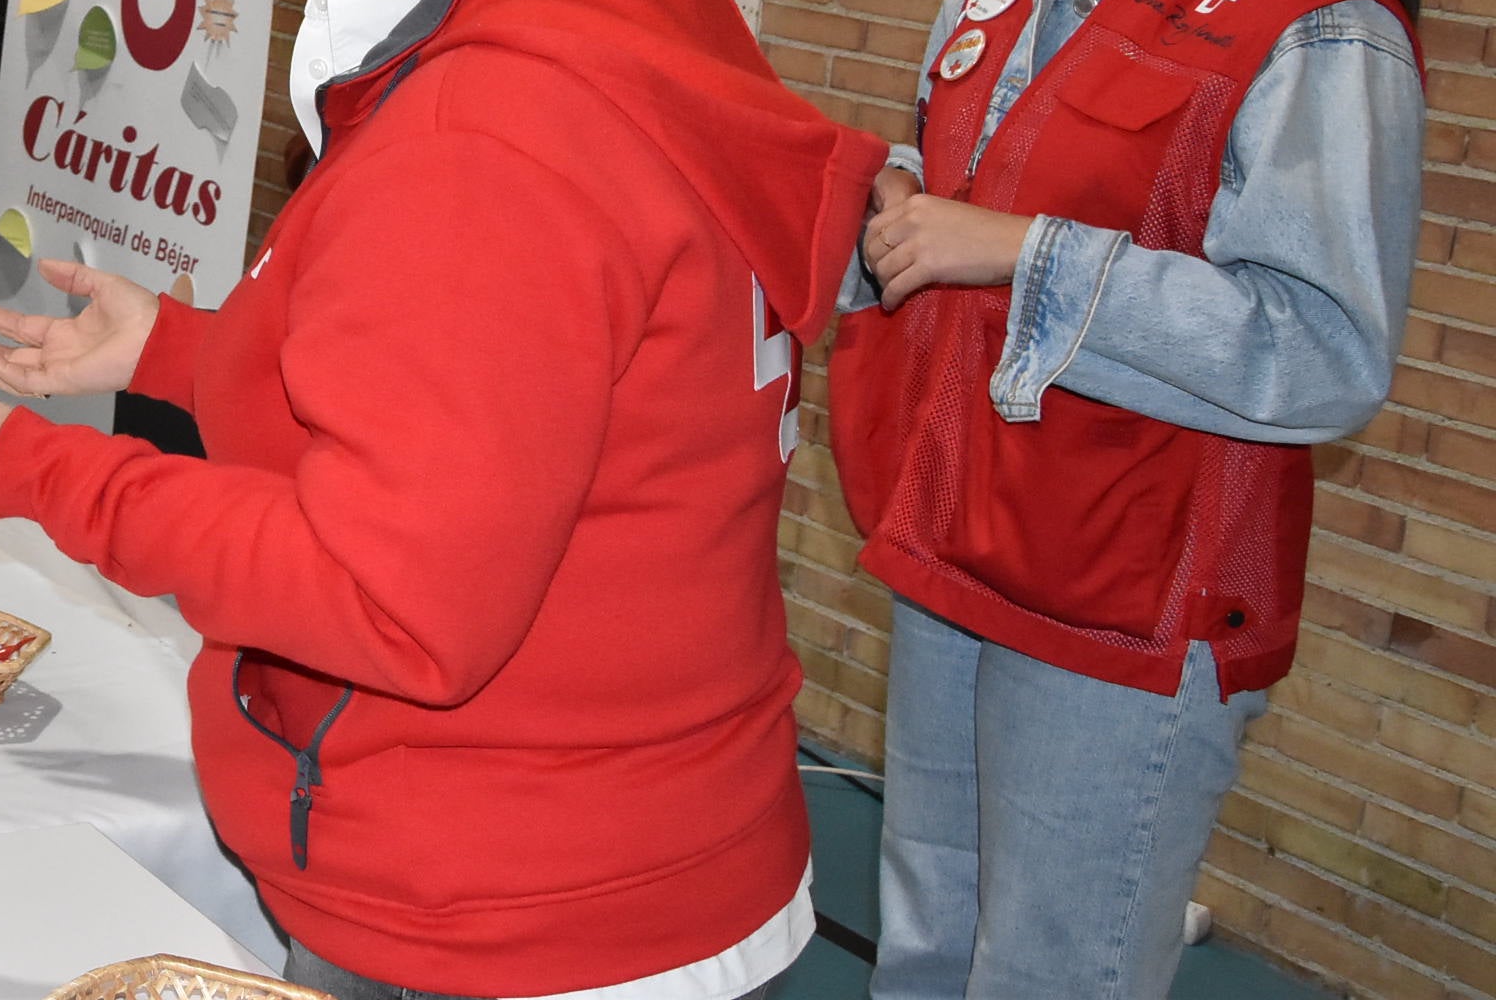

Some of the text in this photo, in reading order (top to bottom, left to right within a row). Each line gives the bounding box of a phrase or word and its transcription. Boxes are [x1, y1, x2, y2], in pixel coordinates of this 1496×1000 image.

[23, 95, 222, 226] Cáritas
[26, 184, 199, 274] Interparroquial de Béjar
